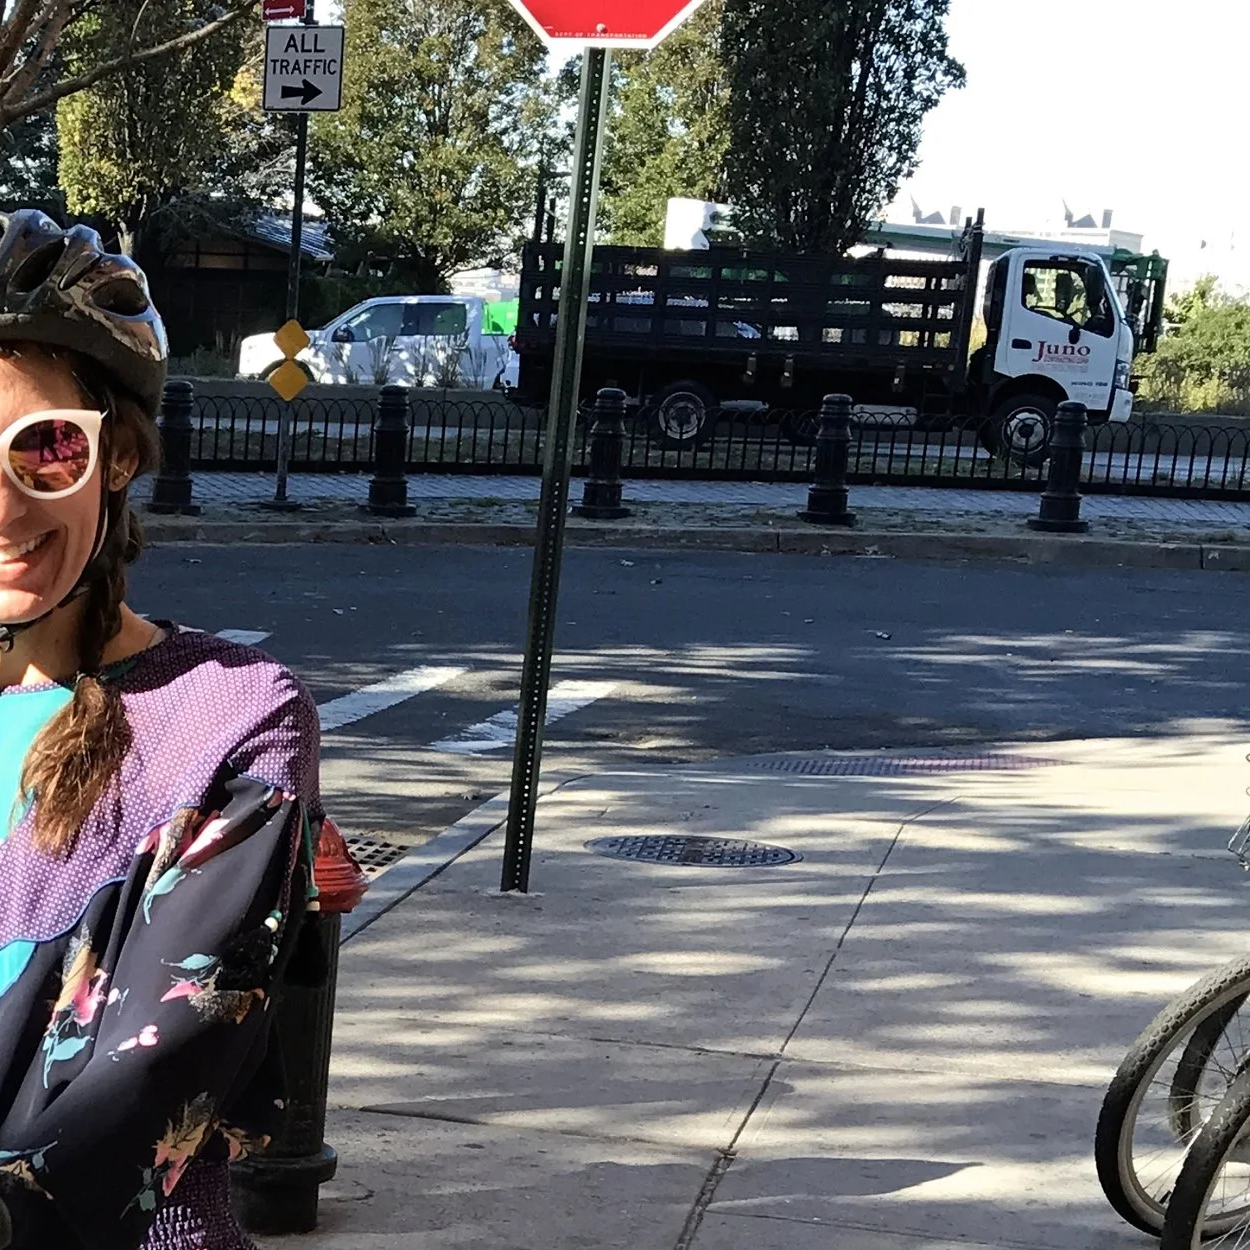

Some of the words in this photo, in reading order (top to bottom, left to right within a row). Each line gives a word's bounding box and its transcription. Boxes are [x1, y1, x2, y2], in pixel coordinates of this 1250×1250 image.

[284, 33, 326, 53] ALL
[270, 58, 338, 76] TRAFFIC
[1031, 340, 1091, 363] Juno
